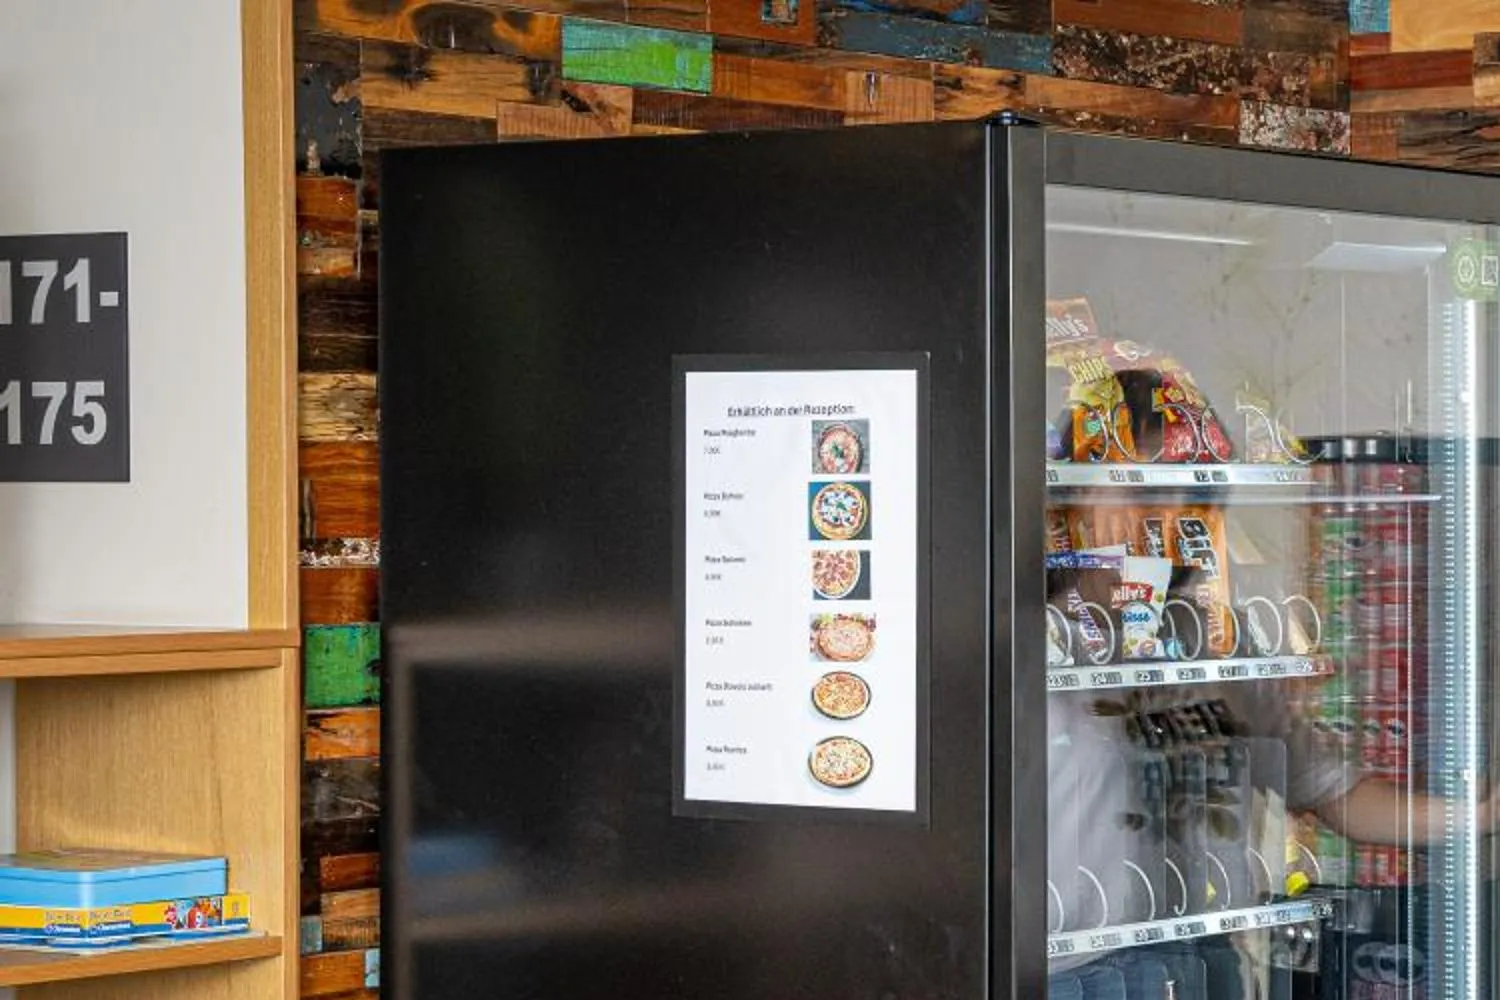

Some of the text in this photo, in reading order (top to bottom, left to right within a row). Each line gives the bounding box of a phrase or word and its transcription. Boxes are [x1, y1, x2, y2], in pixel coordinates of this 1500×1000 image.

[0, 380, 107, 445] 175
[773, 408, 787, 417] an
[787, 405, 803, 416] der
